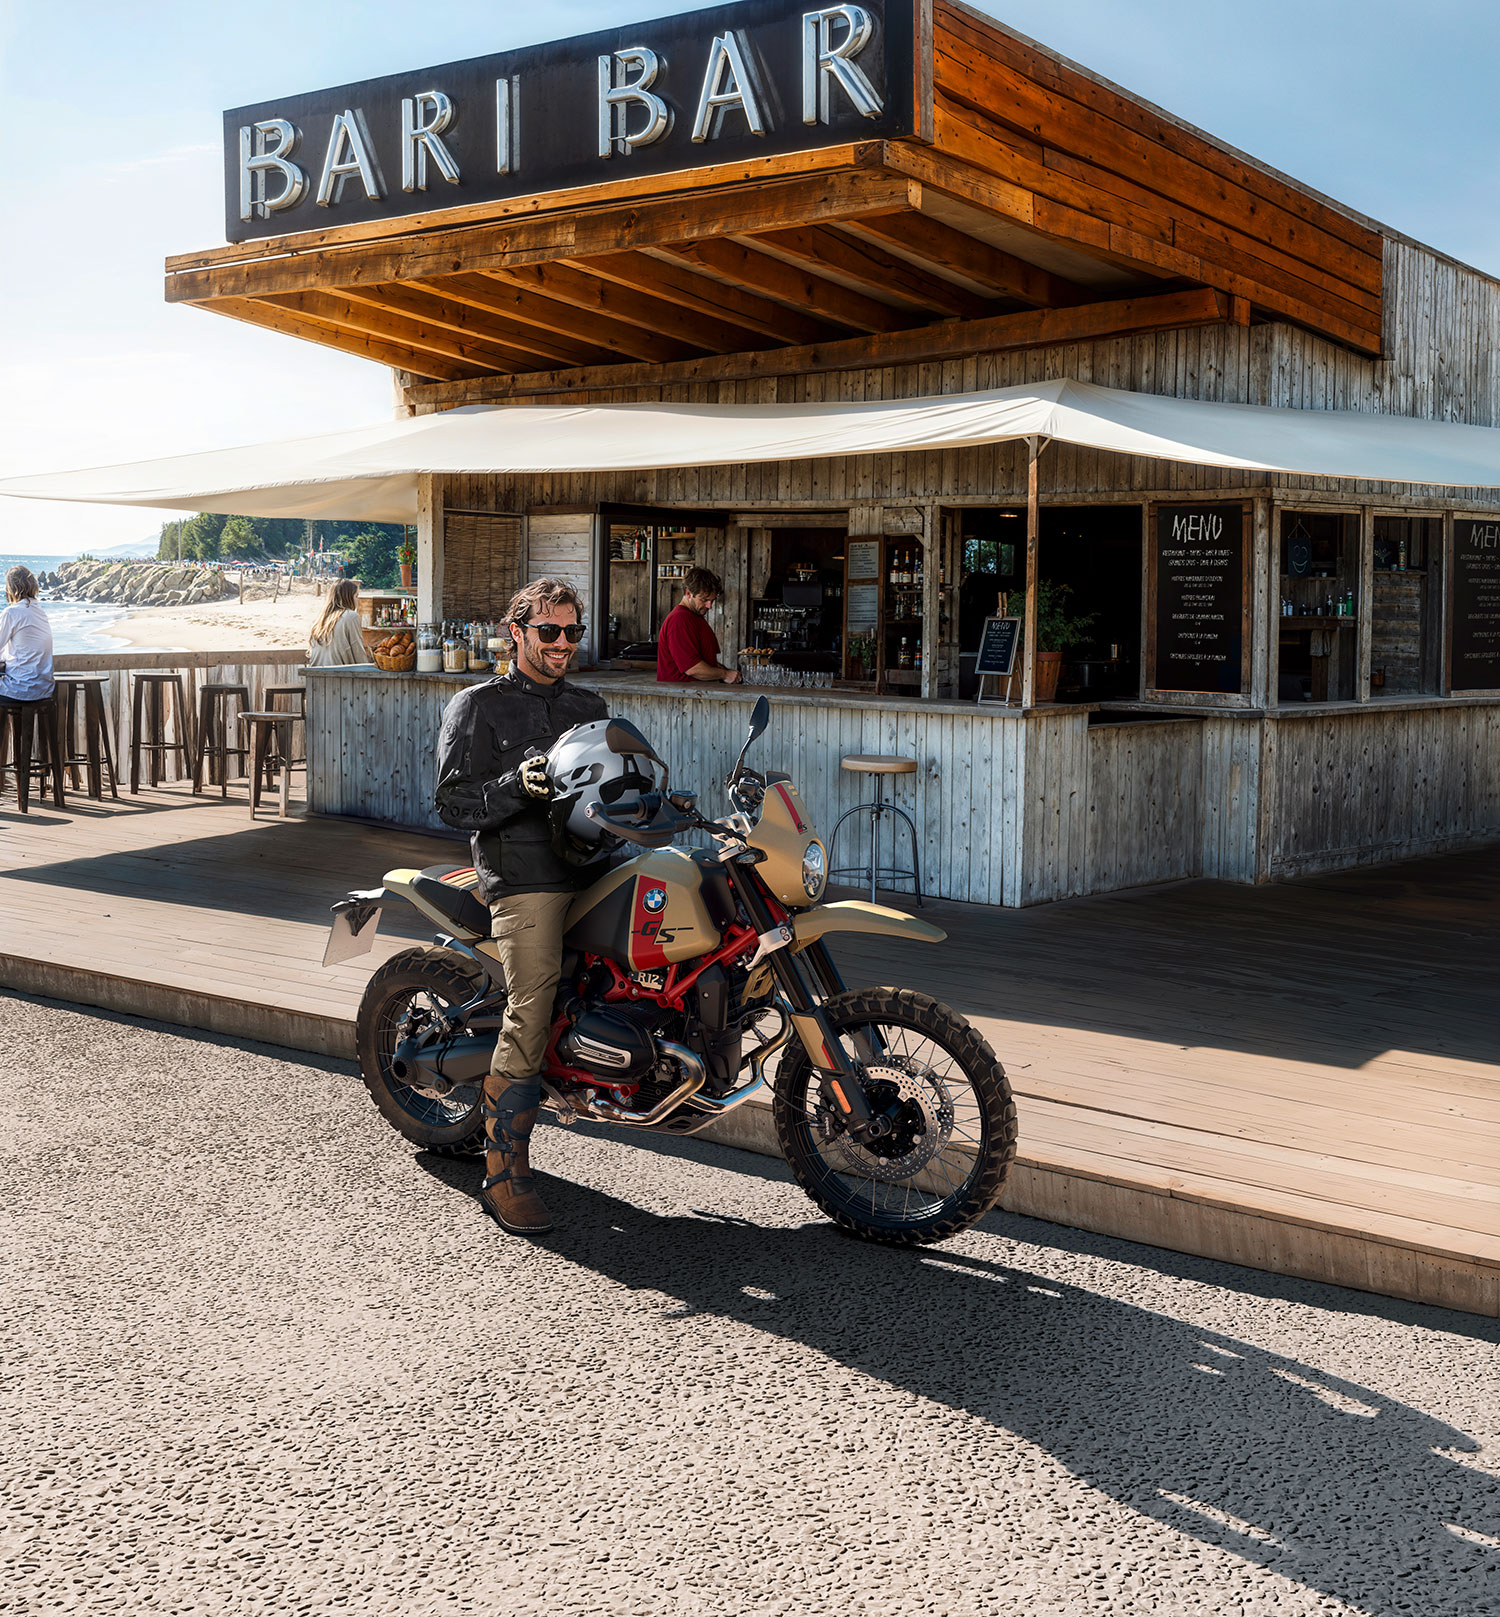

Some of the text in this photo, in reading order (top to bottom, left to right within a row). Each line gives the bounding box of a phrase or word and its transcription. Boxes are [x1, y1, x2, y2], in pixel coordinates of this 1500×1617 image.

[239, 3, 885, 223] BARI BAR
[1171, 513, 1223, 544] MENU
